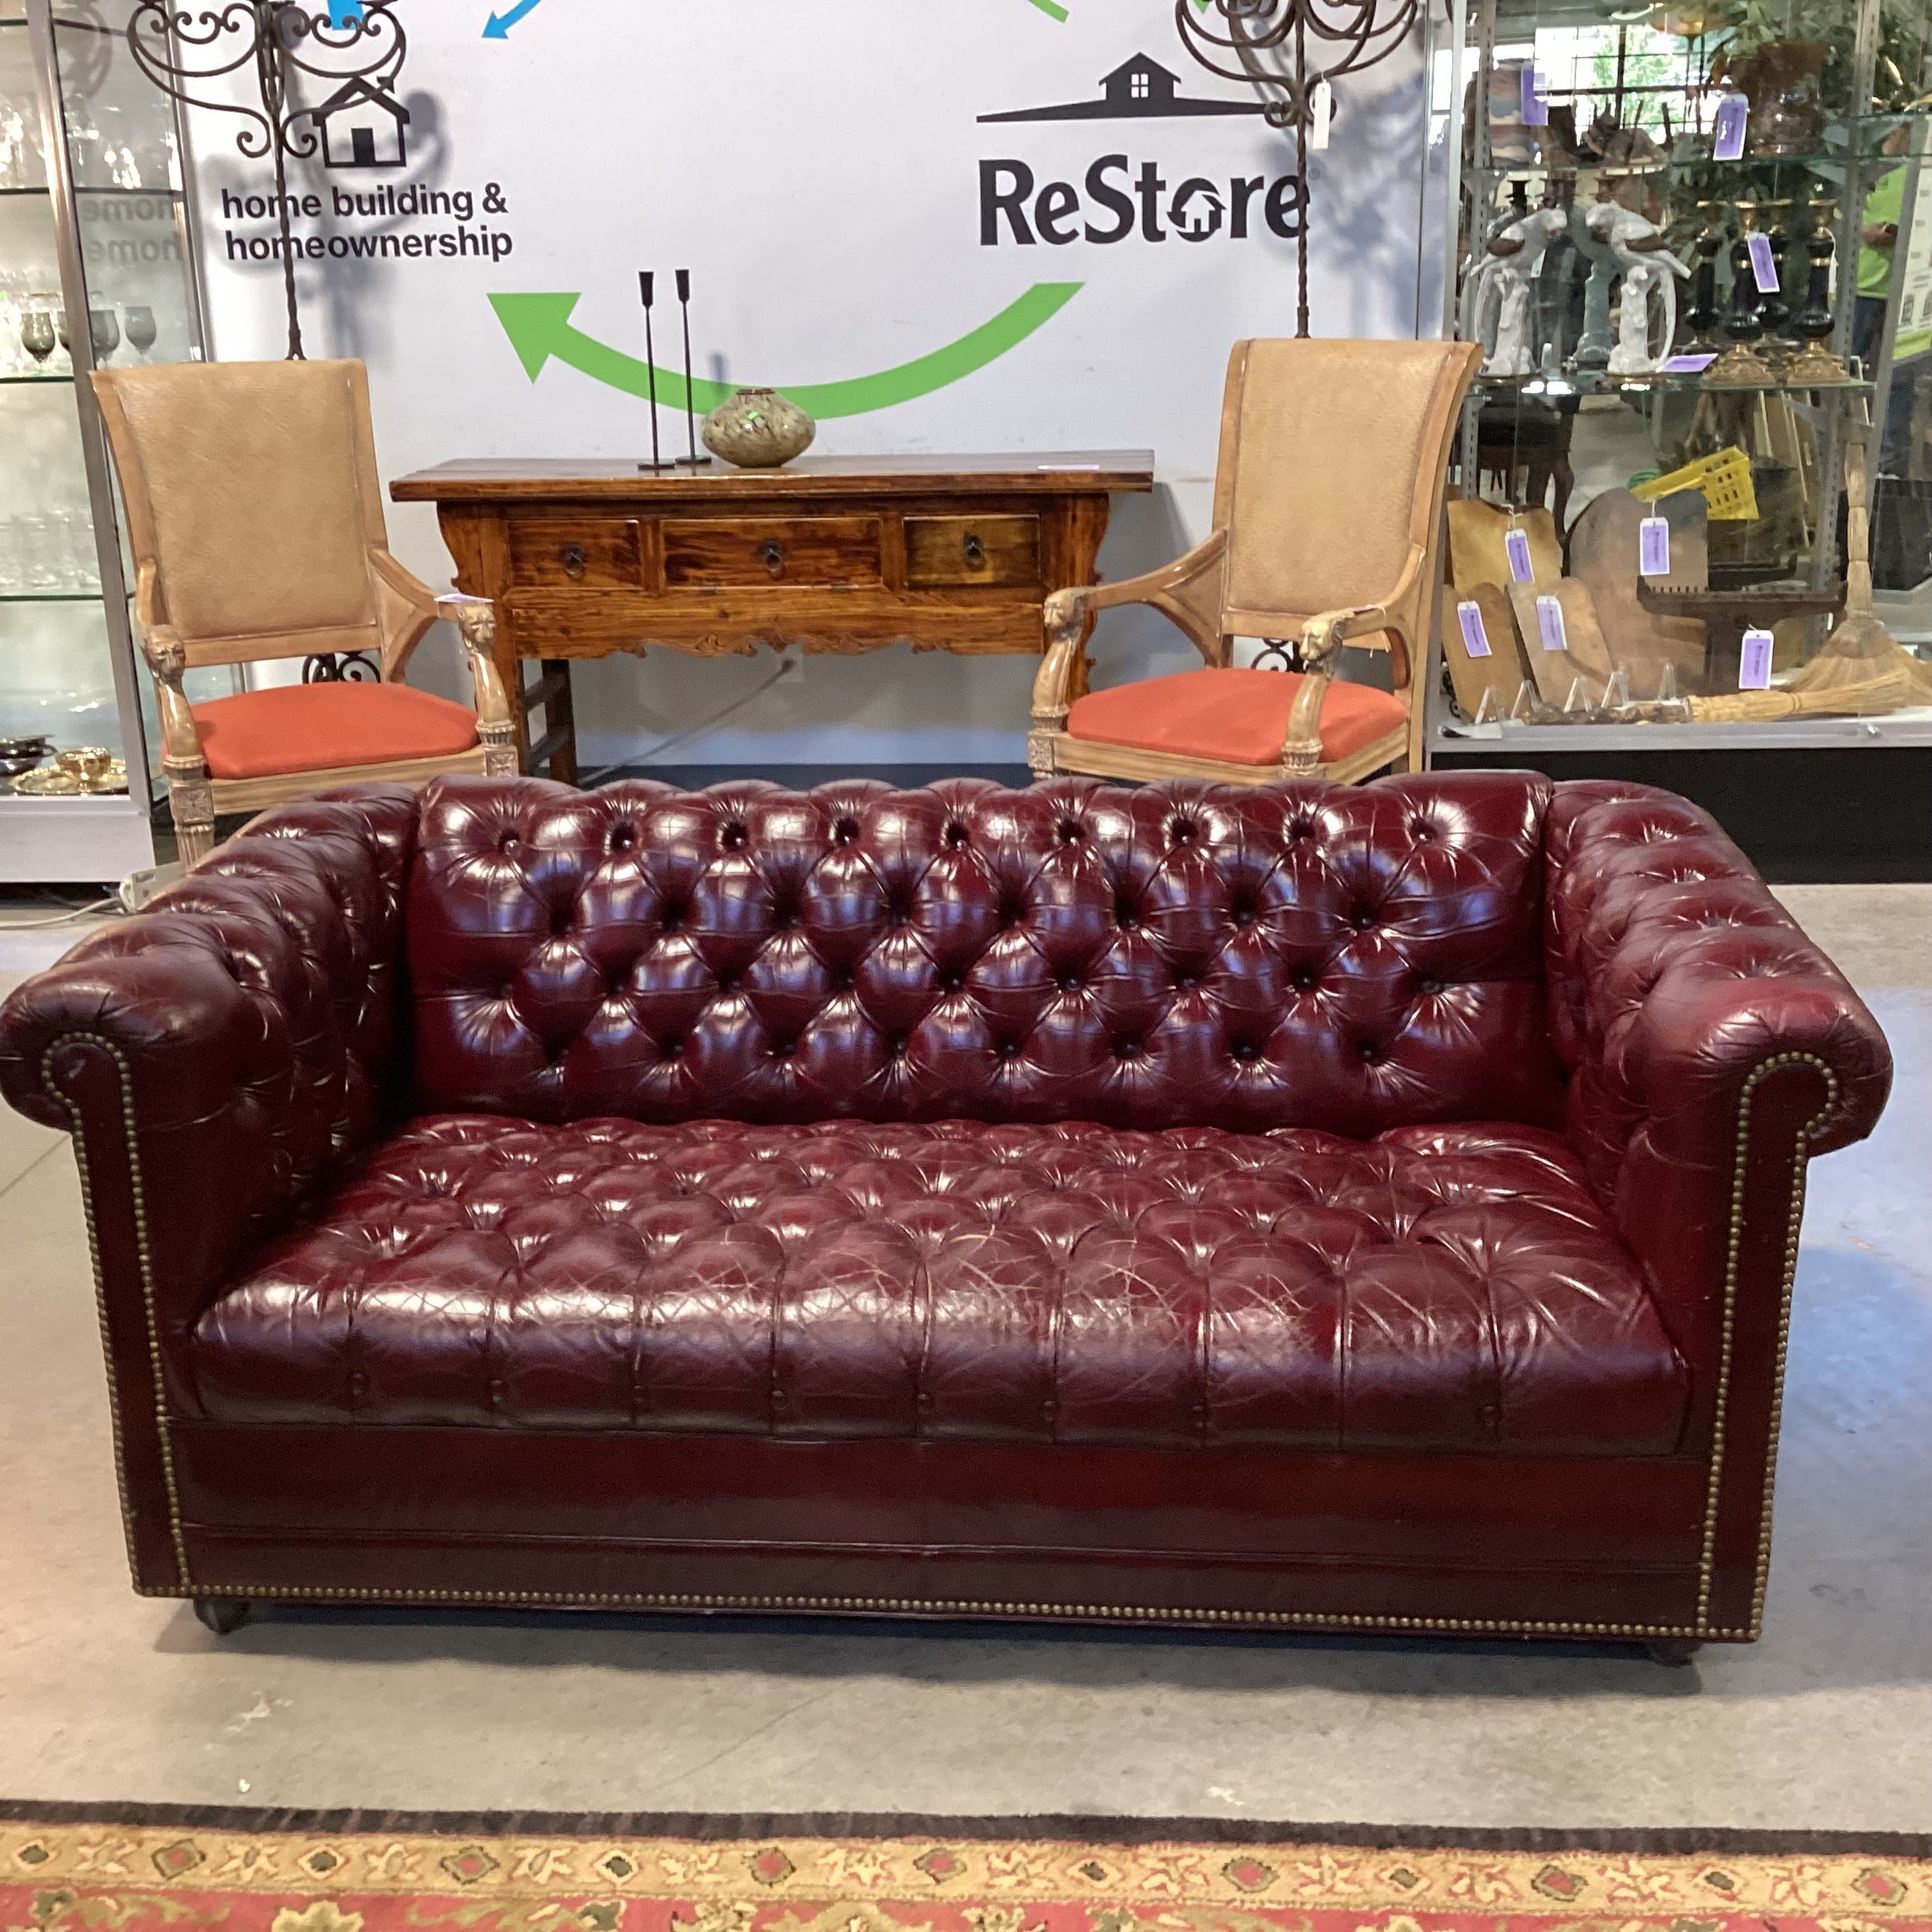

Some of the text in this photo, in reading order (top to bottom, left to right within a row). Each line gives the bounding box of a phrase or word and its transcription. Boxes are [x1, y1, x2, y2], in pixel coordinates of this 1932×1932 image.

[222, 182, 509, 221] home building &
[979, 154, 1310, 245] ReStore
[225, 225, 513, 262] homeownership
